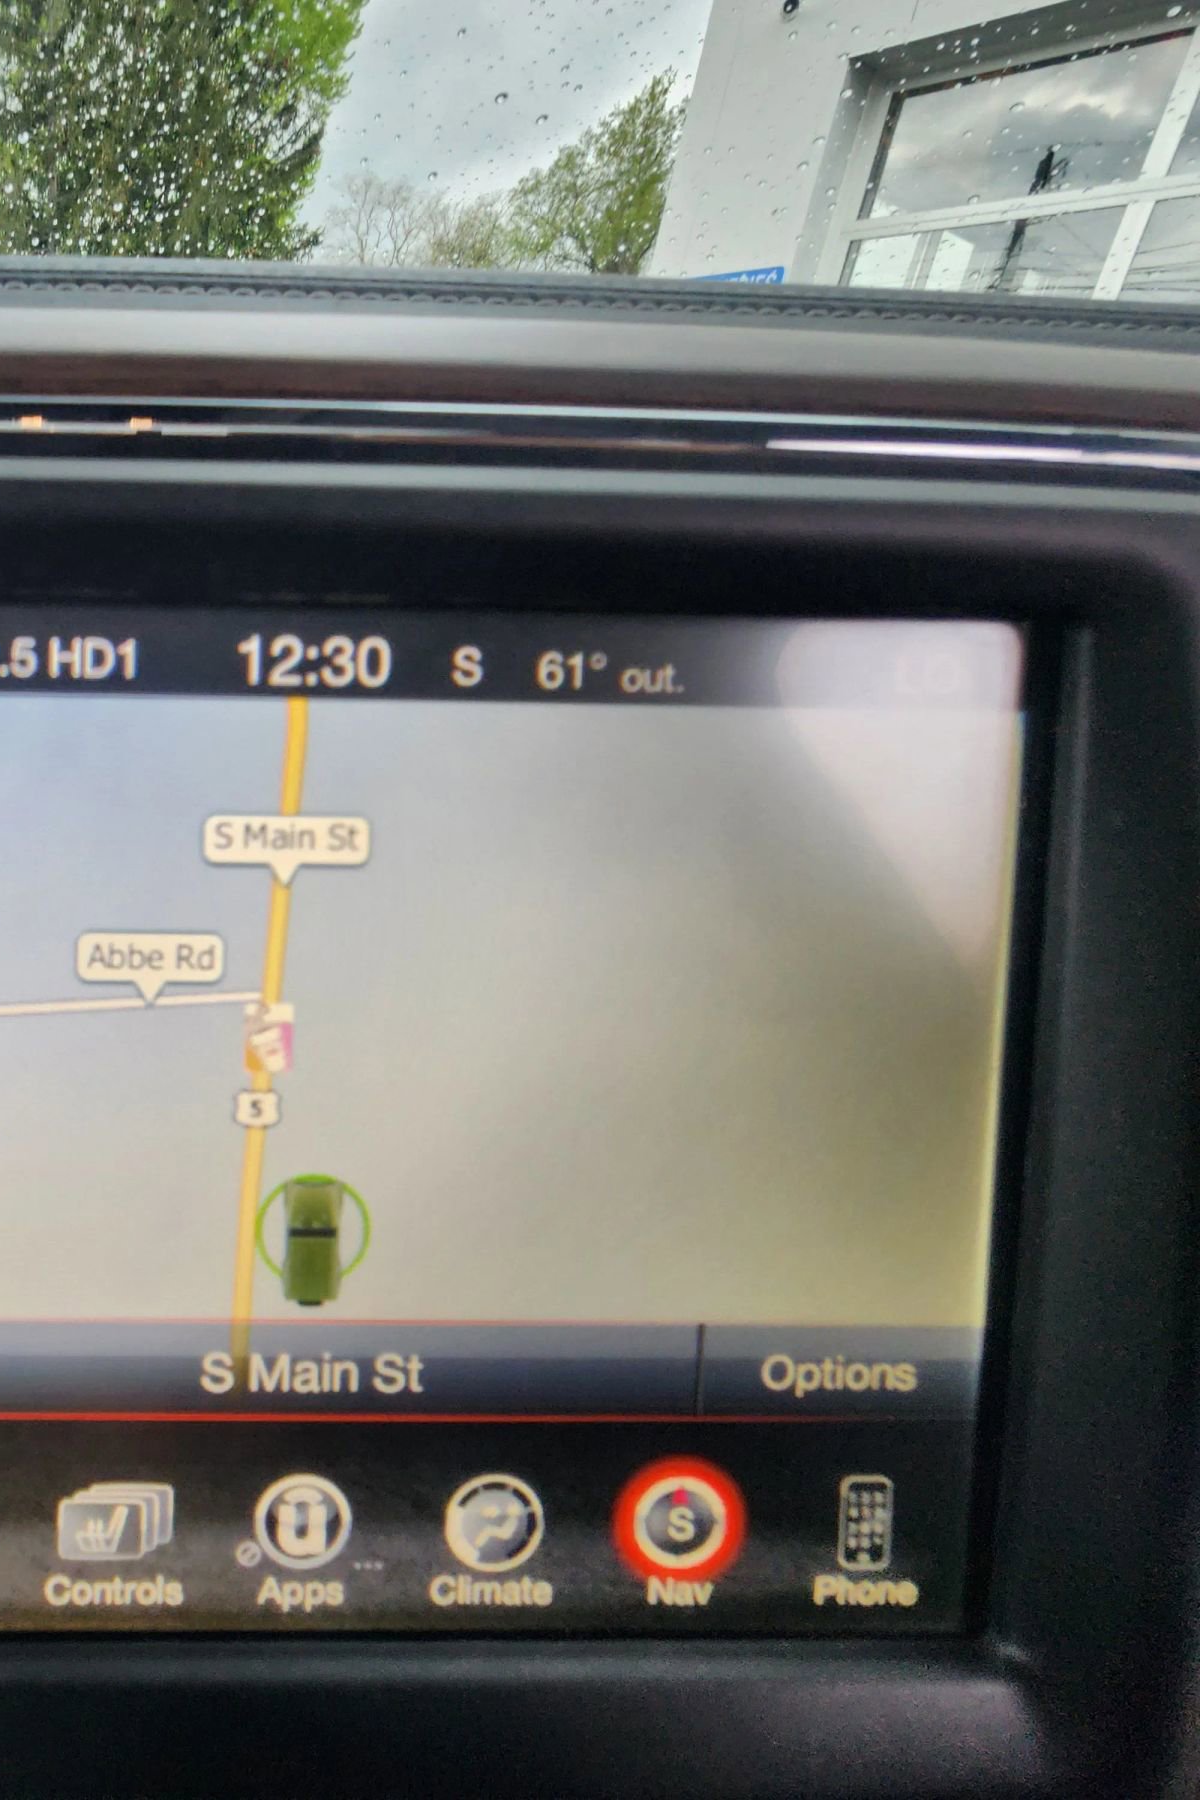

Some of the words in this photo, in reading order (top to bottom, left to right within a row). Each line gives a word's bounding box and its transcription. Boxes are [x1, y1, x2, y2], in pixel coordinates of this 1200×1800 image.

[47, 636, 139, 680] HD1
[237, 633, 393, 688] 12:30
[451, 645, 485, 688] S
[535, 651, 607, 690] 61°
[620, 662, 685, 694] out.
[213, 822, 233, 851] S
[243, 822, 316, 851] Main
[327, 823, 361, 852] St
[87, 943, 165, 971] Abbe
[176, 944, 216, 971] Rd
[200, 1351, 235, 1394] S
[248, 1352, 359, 1393] Main
[372, 1353, 424, 1394] St
[761, 1353, 918, 1398] Options
[666, 1505, 697, 1543] S
[43, 1575, 184, 1607] Controls
[257, 1575, 345, 1612] Apps
[429, 1575, 554, 1607] Climate
[646, 1576, 715, 1607] Nav
[813, 1574, 919, 1607] Phone
